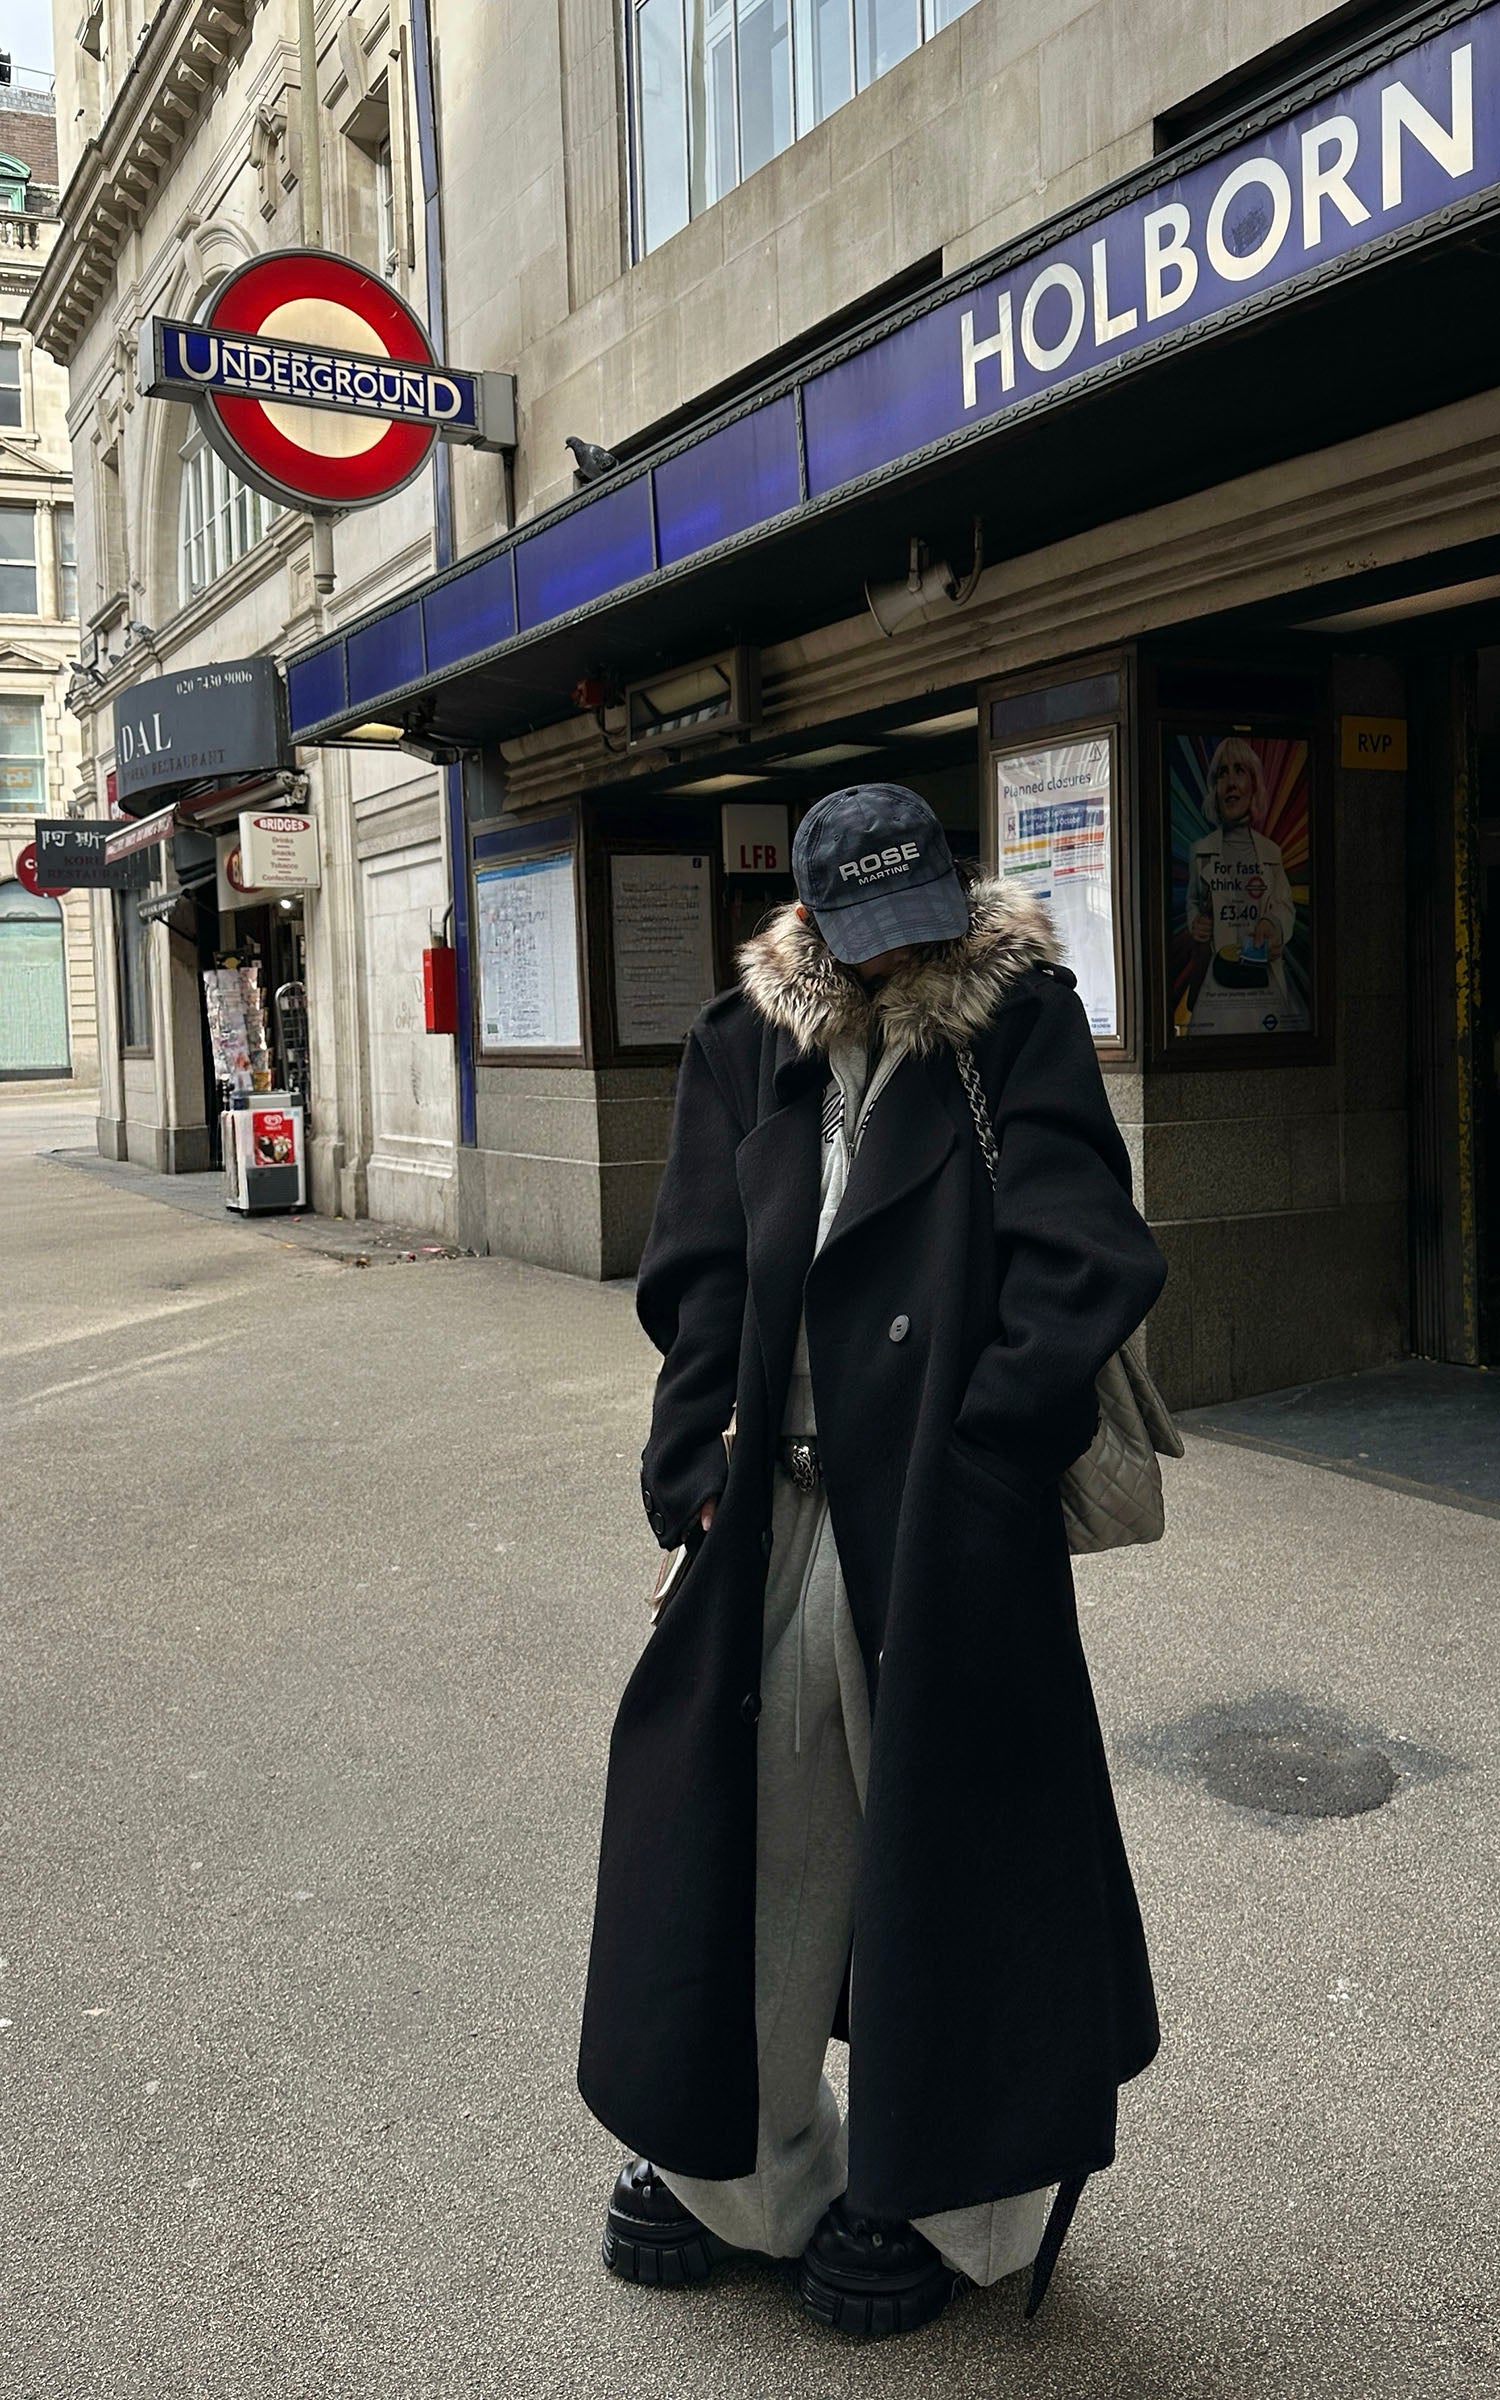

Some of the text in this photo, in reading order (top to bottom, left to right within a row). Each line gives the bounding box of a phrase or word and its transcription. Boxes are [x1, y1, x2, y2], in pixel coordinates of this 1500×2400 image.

[961, 43, 1473, 409] HOLBORN
[178, 332, 462, 419] UNDERGROUND
[176, 670, 253, 695] 020 7430 9006
[1358, 733, 1393, 753] RVP
[1003, 772, 1092, 799] Planned closures
[259, 818, 305, 831] BRIDGES
[271, 836, 294, 845] Drinks
[271, 849, 296, 857] Snacks
[740, 844, 777, 869] LFB
[839, 842, 920, 882] ROSE
[270, 861, 299, 870] Tobacco
[858, 863, 910, 886] MARTINE
[1214, 861, 1232, 874] For
[262, 874, 308, 884] Confectionery
[1210, 877, 1242, 891] think
[1220, 904, 1259, 921] £3.40
